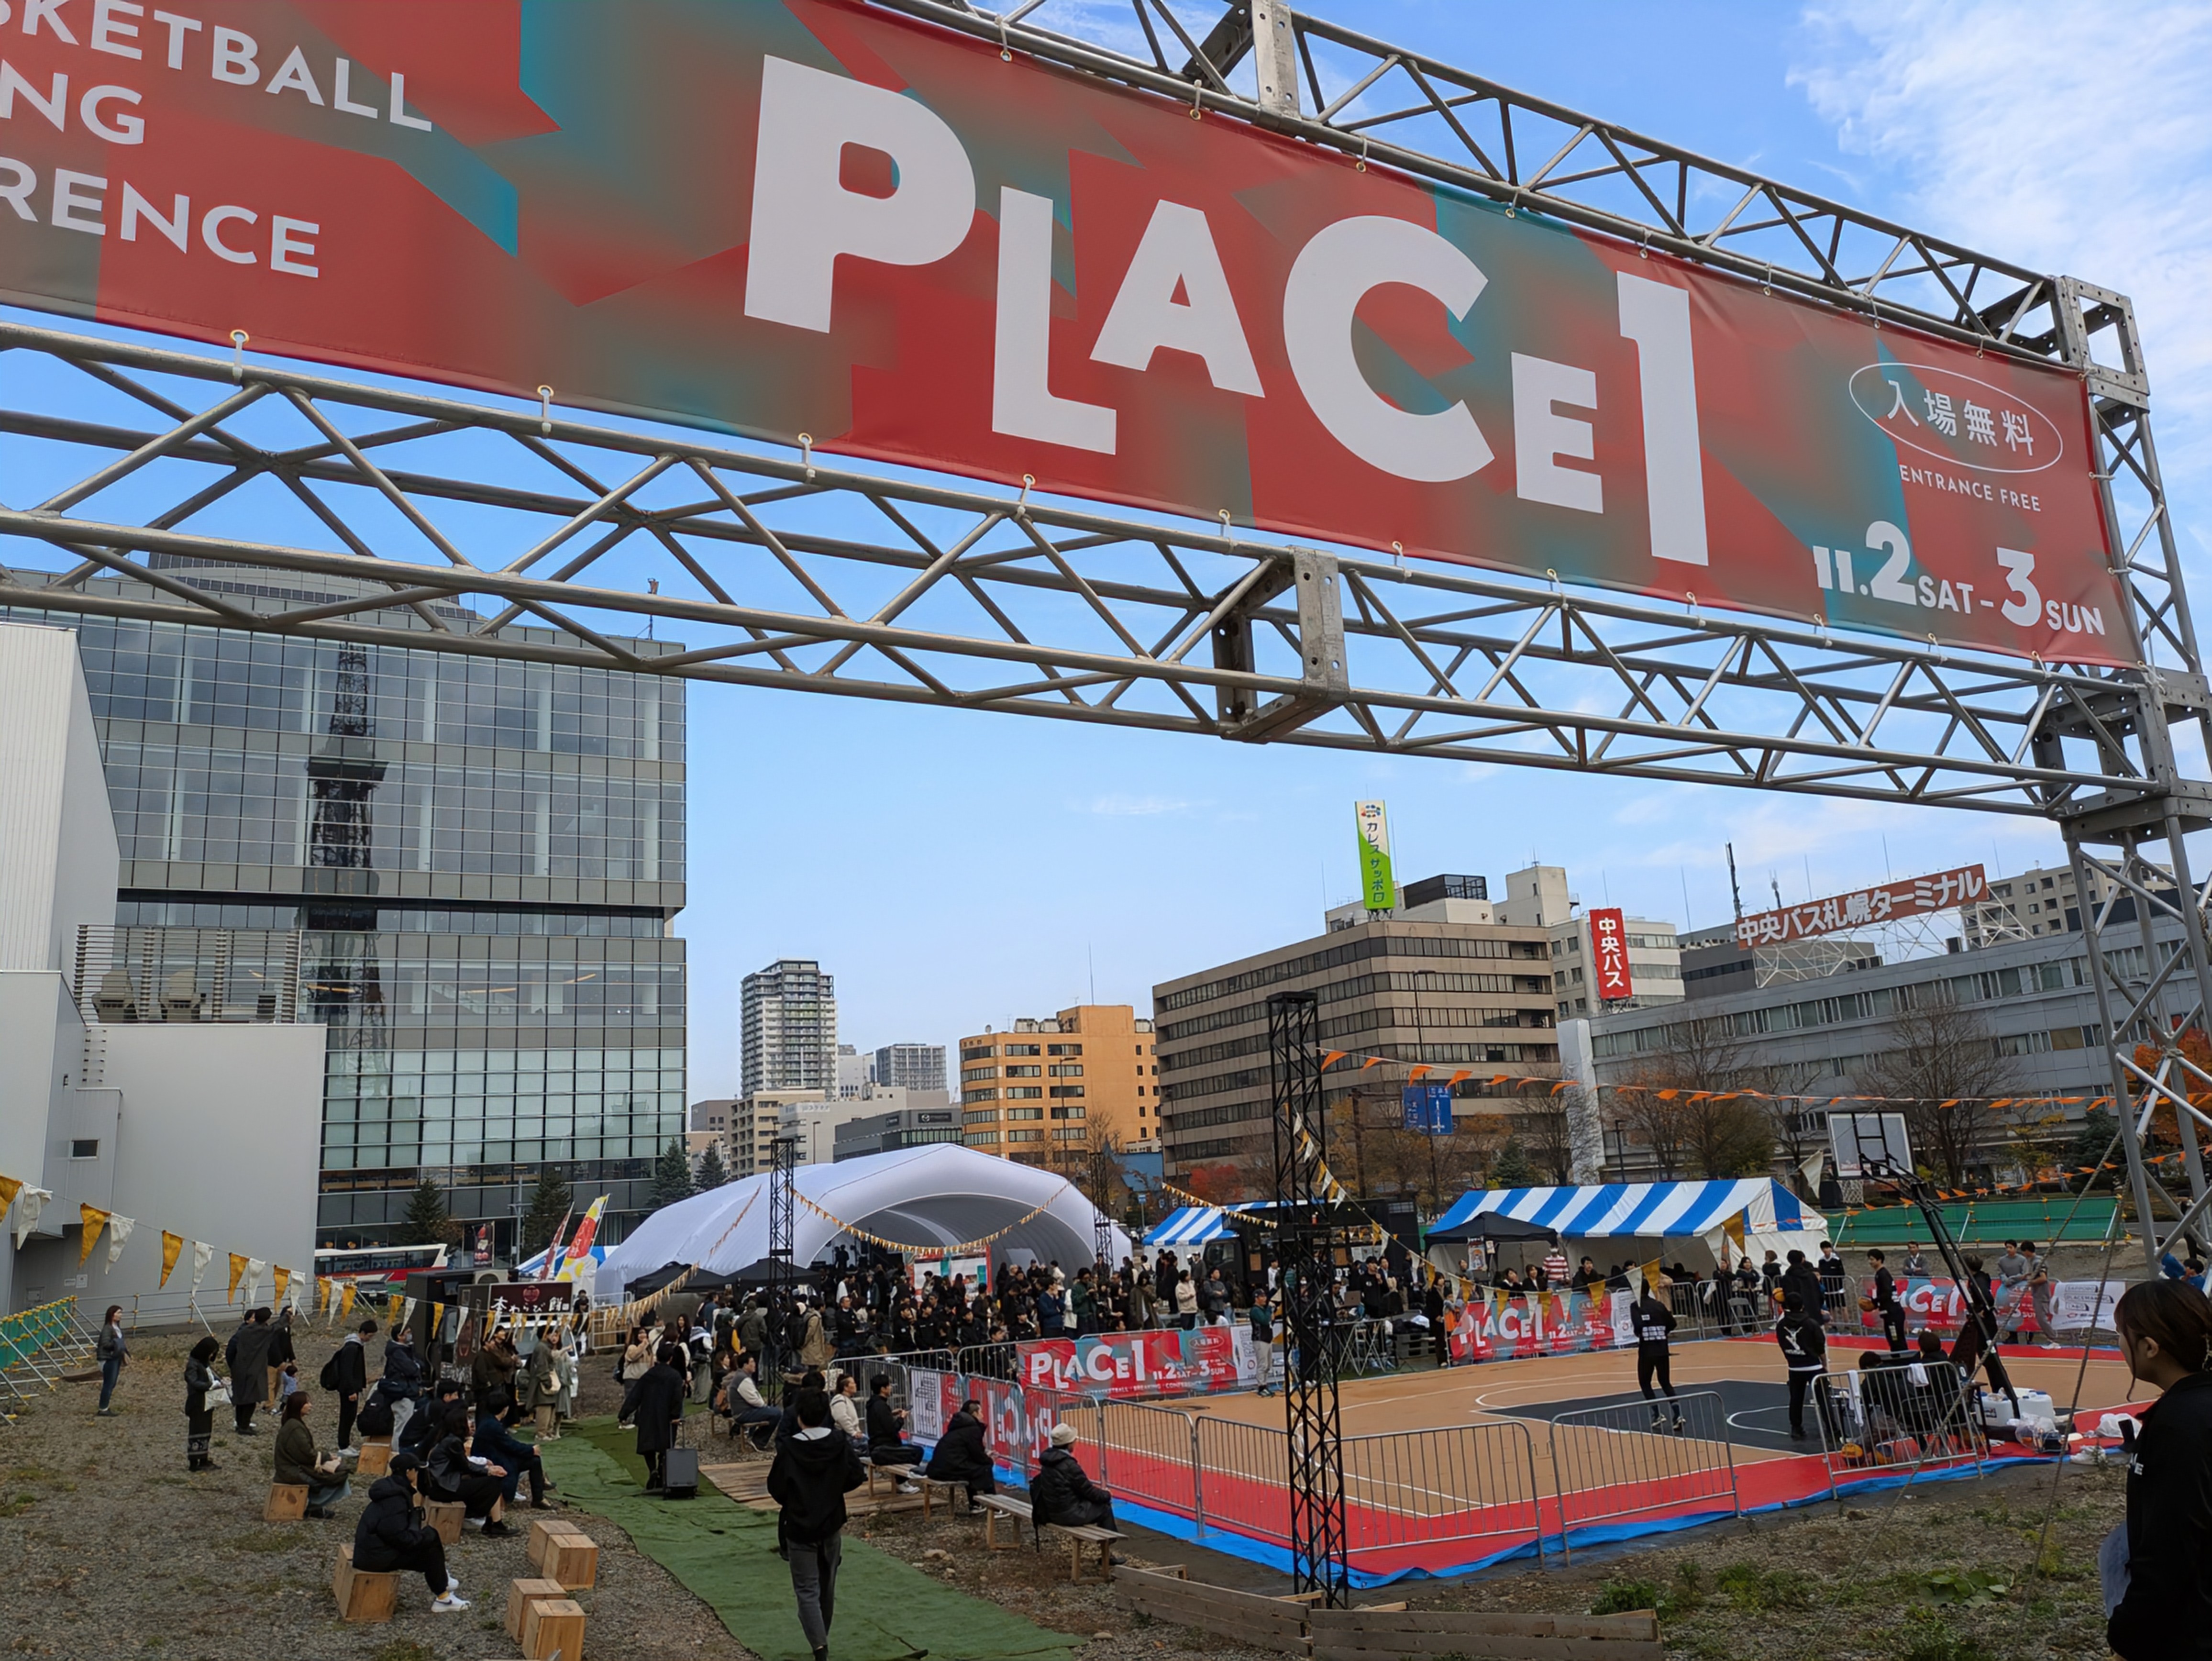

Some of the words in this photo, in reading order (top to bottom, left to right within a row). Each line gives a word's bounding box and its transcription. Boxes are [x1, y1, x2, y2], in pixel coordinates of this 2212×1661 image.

[0, 0, 432, 133] KETBALL
[744, 55, 1709, 566] PLACE1
[1887, 380, 2034, 456] 入場無料
[1899, 465, 1993, 501] ENTRANCE
[2000, 487, 2042, 512] FREE
[1737, 870, 1983, 947] 中央バス札幌ターミナル
[1598, 917, 1625, 989] 中央バス
[1030, 1340, 1145, 1389] PLACE1
